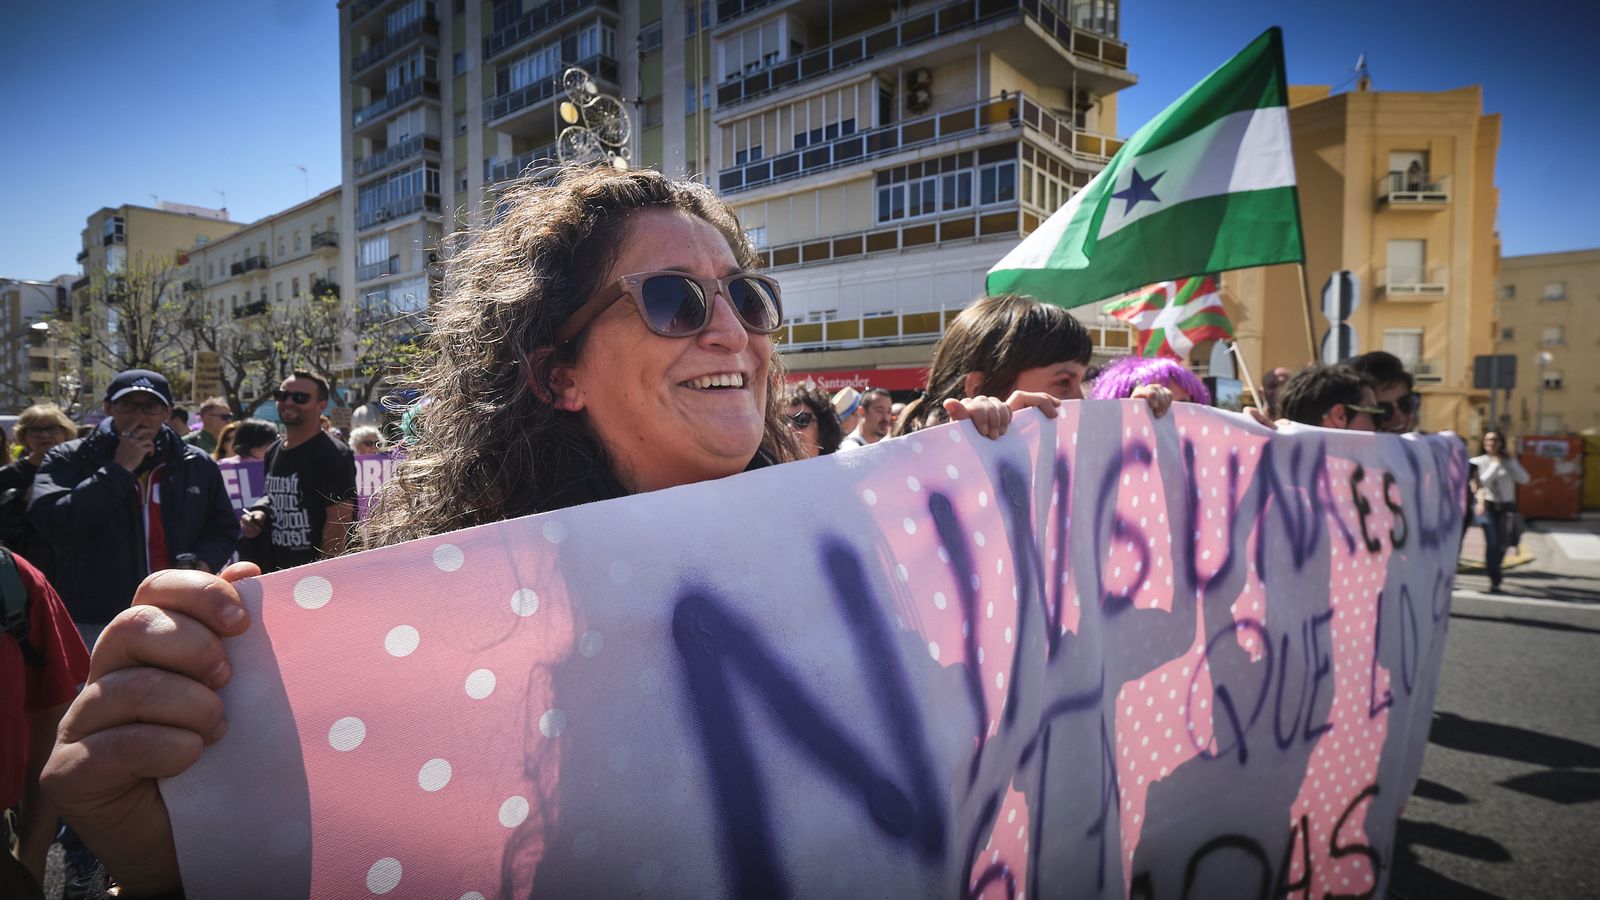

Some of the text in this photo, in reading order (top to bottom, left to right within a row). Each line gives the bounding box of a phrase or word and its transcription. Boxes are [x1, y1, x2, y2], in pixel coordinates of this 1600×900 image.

[817, 374, 870, 388] Santander
[1351, 462, 1407, 554] ES
[1186, 607, 1335, 767] QUE
[1369, 583, 1418, 718] LO
